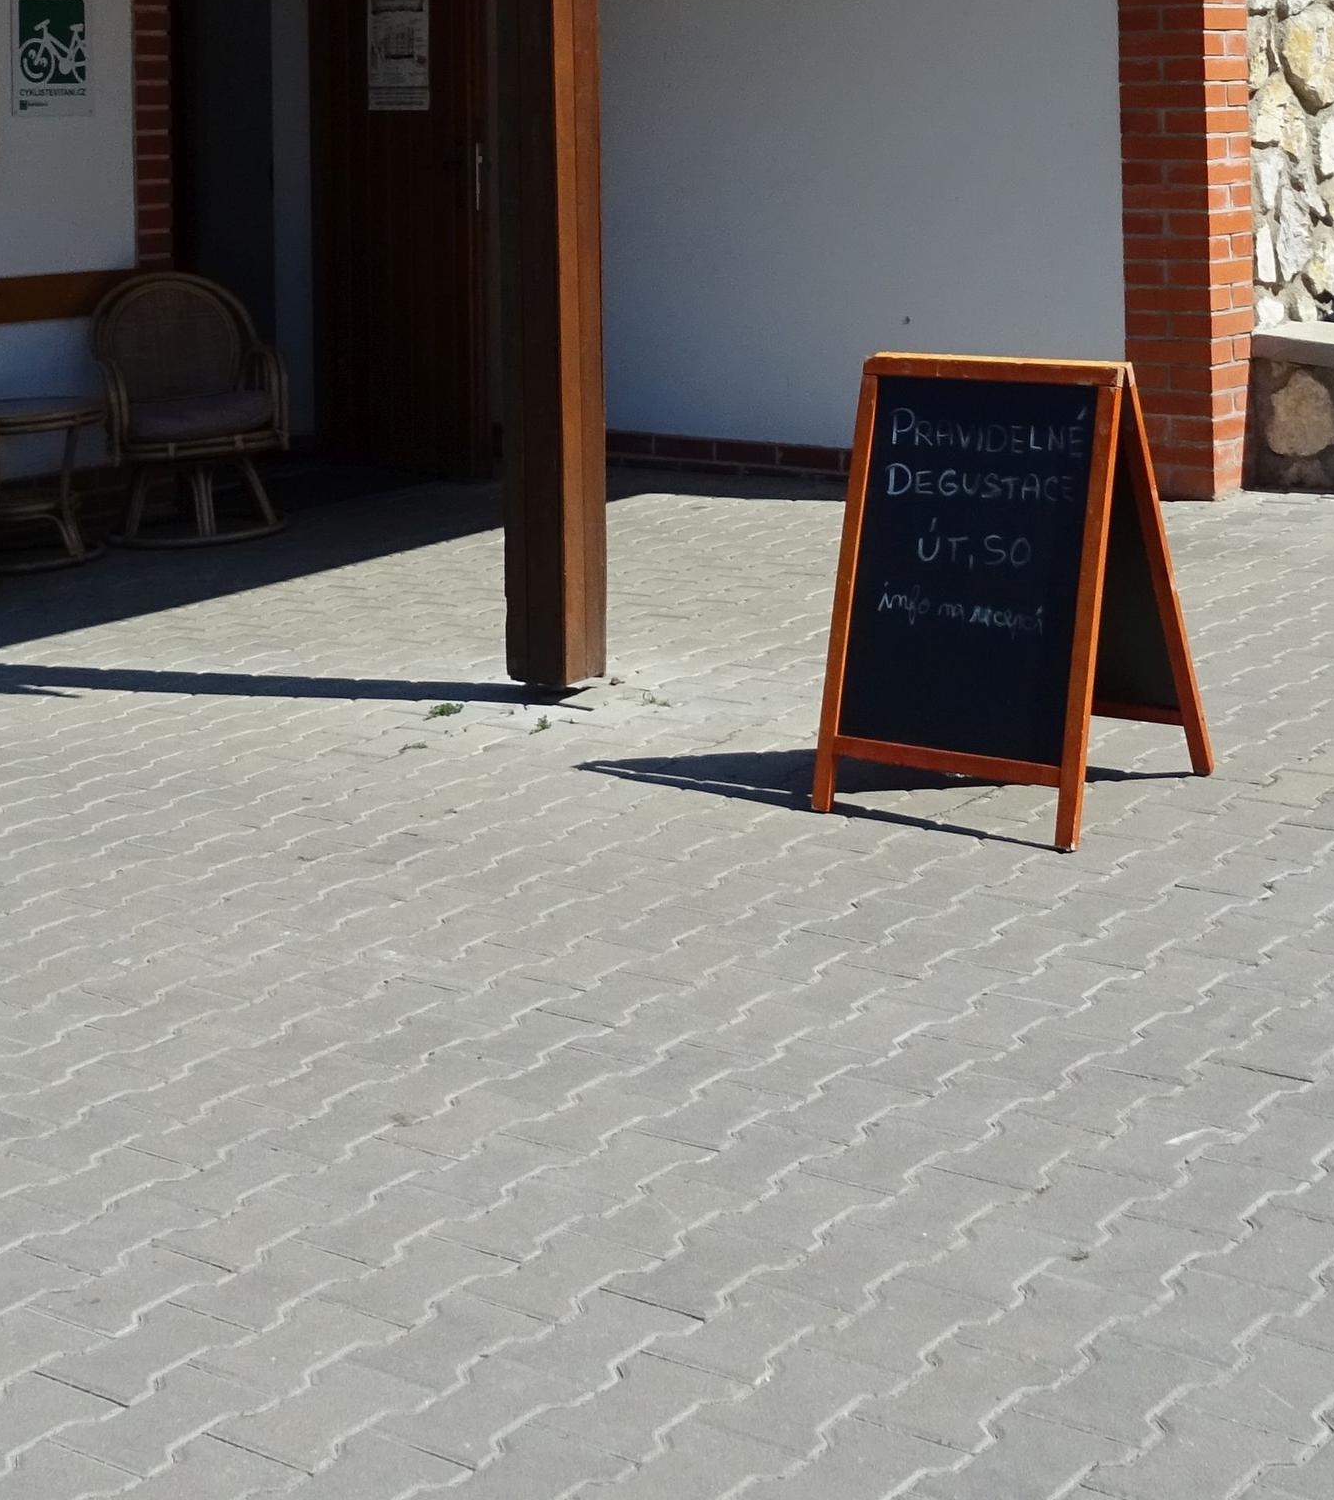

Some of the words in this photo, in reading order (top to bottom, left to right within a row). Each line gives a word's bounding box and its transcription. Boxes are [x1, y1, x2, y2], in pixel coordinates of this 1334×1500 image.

[890, 406, 1089, 459] PRAVIDELNÉ
[883, 462, 1076, 501] DEGUSTACE
[876, 581, 932, 626] info
